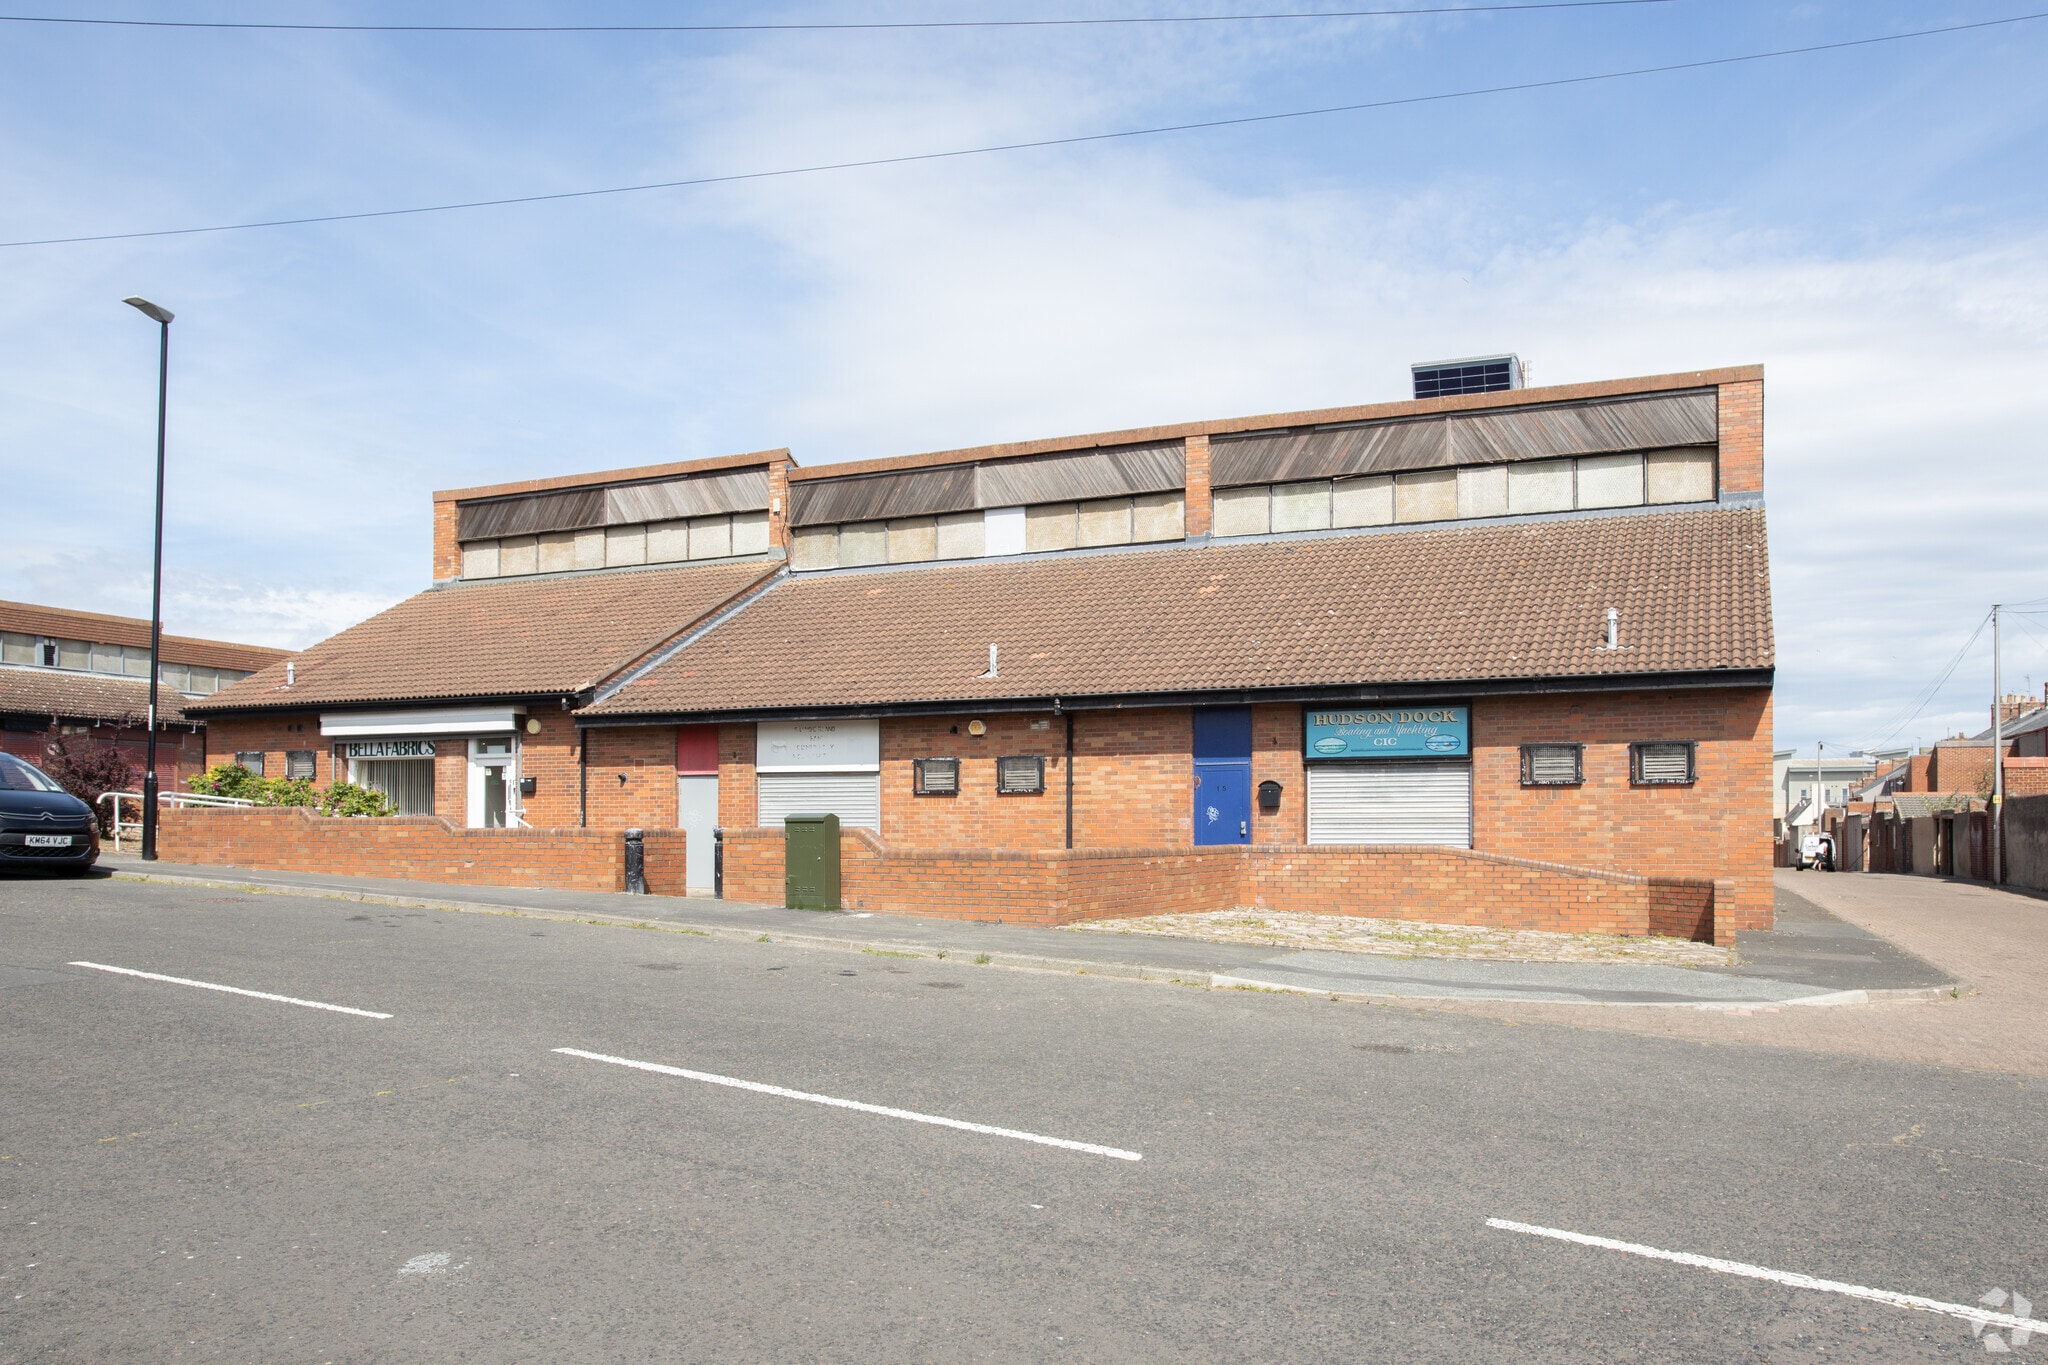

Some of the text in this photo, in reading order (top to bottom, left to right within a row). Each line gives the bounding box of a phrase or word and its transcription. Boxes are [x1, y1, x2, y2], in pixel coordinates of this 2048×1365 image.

[1314, 709, 1458, 726] HUDSON DOCK
[1334, 724, 1438, 739] Boating and Yachting
[349, 740, 435, 757] BELLA FABRICS
[1373, 737, 1397, 746] CIC
